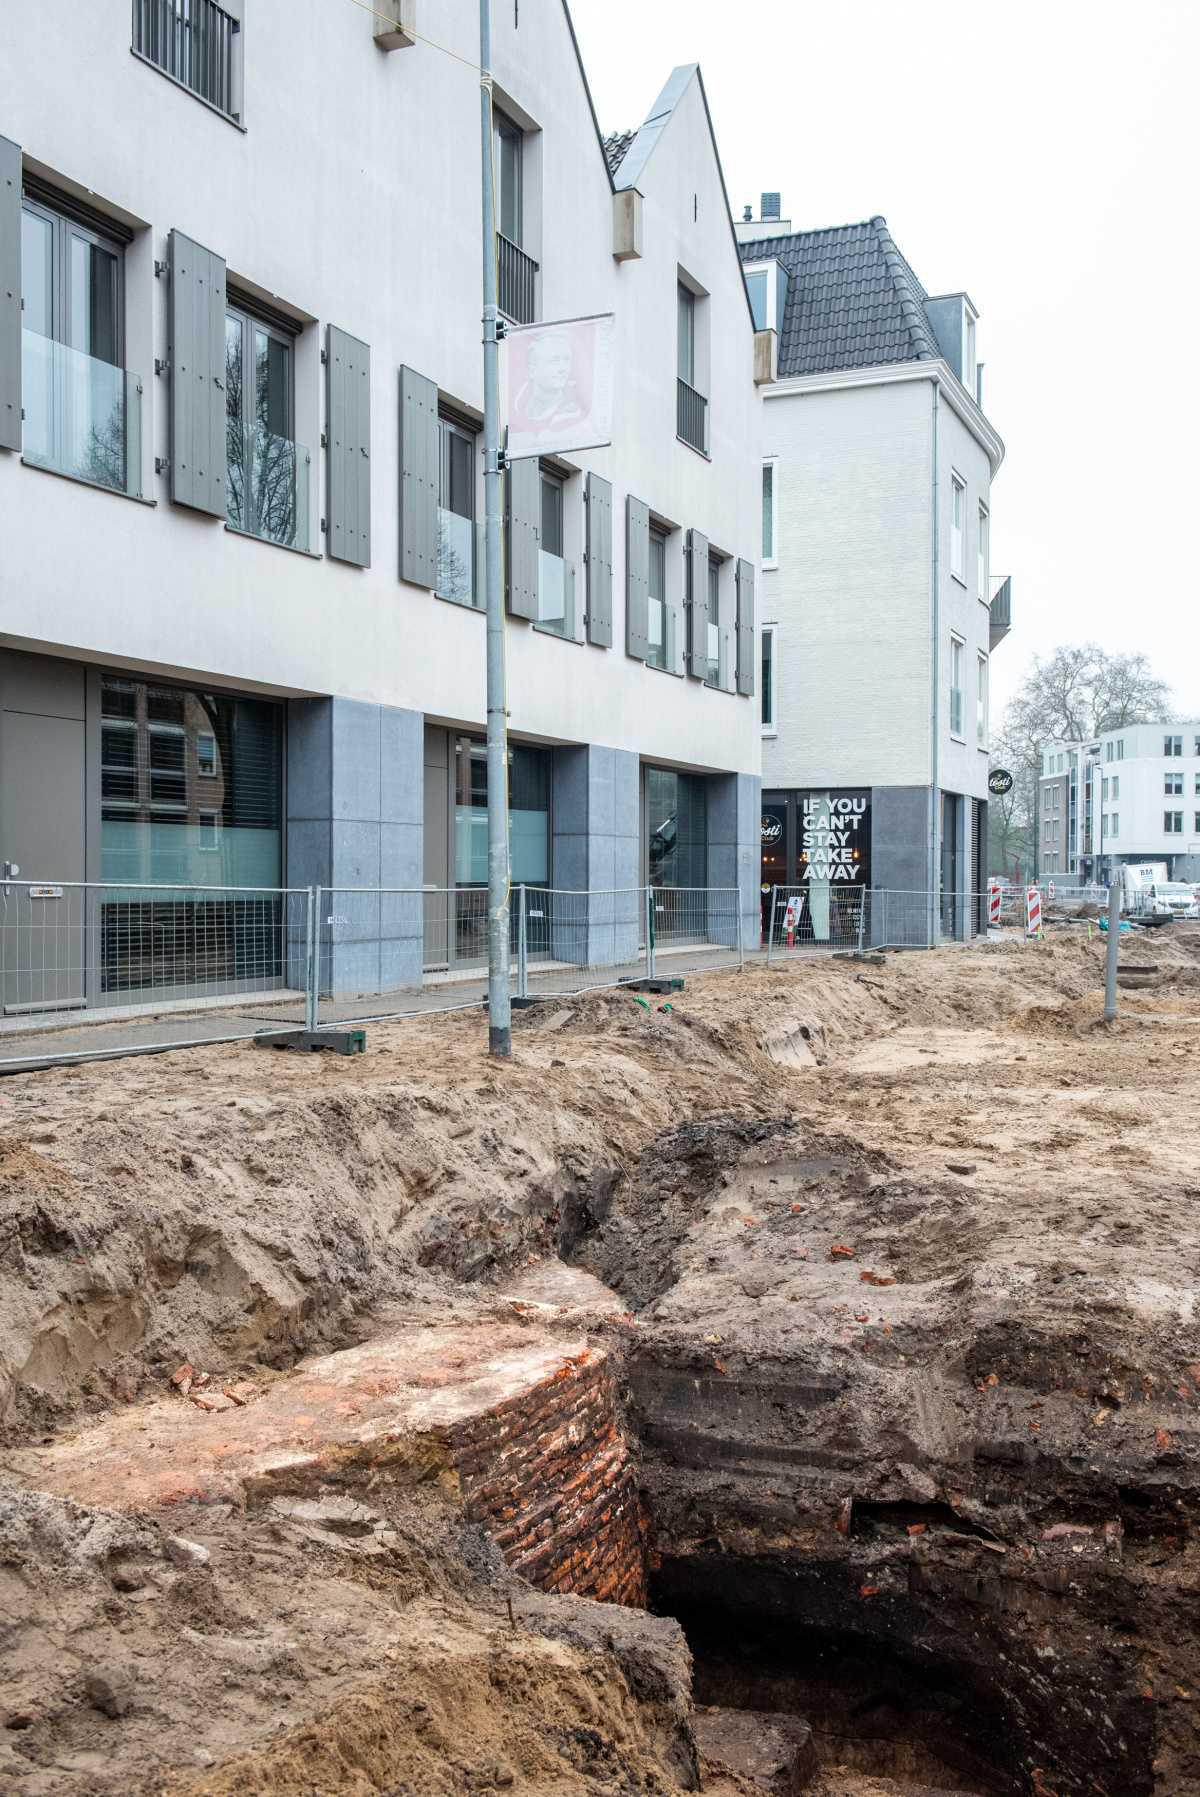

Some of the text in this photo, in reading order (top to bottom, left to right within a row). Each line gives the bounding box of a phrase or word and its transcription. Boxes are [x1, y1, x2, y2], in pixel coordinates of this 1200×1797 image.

[803, 798, 866, 814] IF YOU
[760, 824, 781, 836] osti
[802, 815, 862, 830] CAN'T
[802, 831, 850, 847] STAY
[802, 847, 853, 863] TAKE
[802, 864, 860, 880] AWAY
